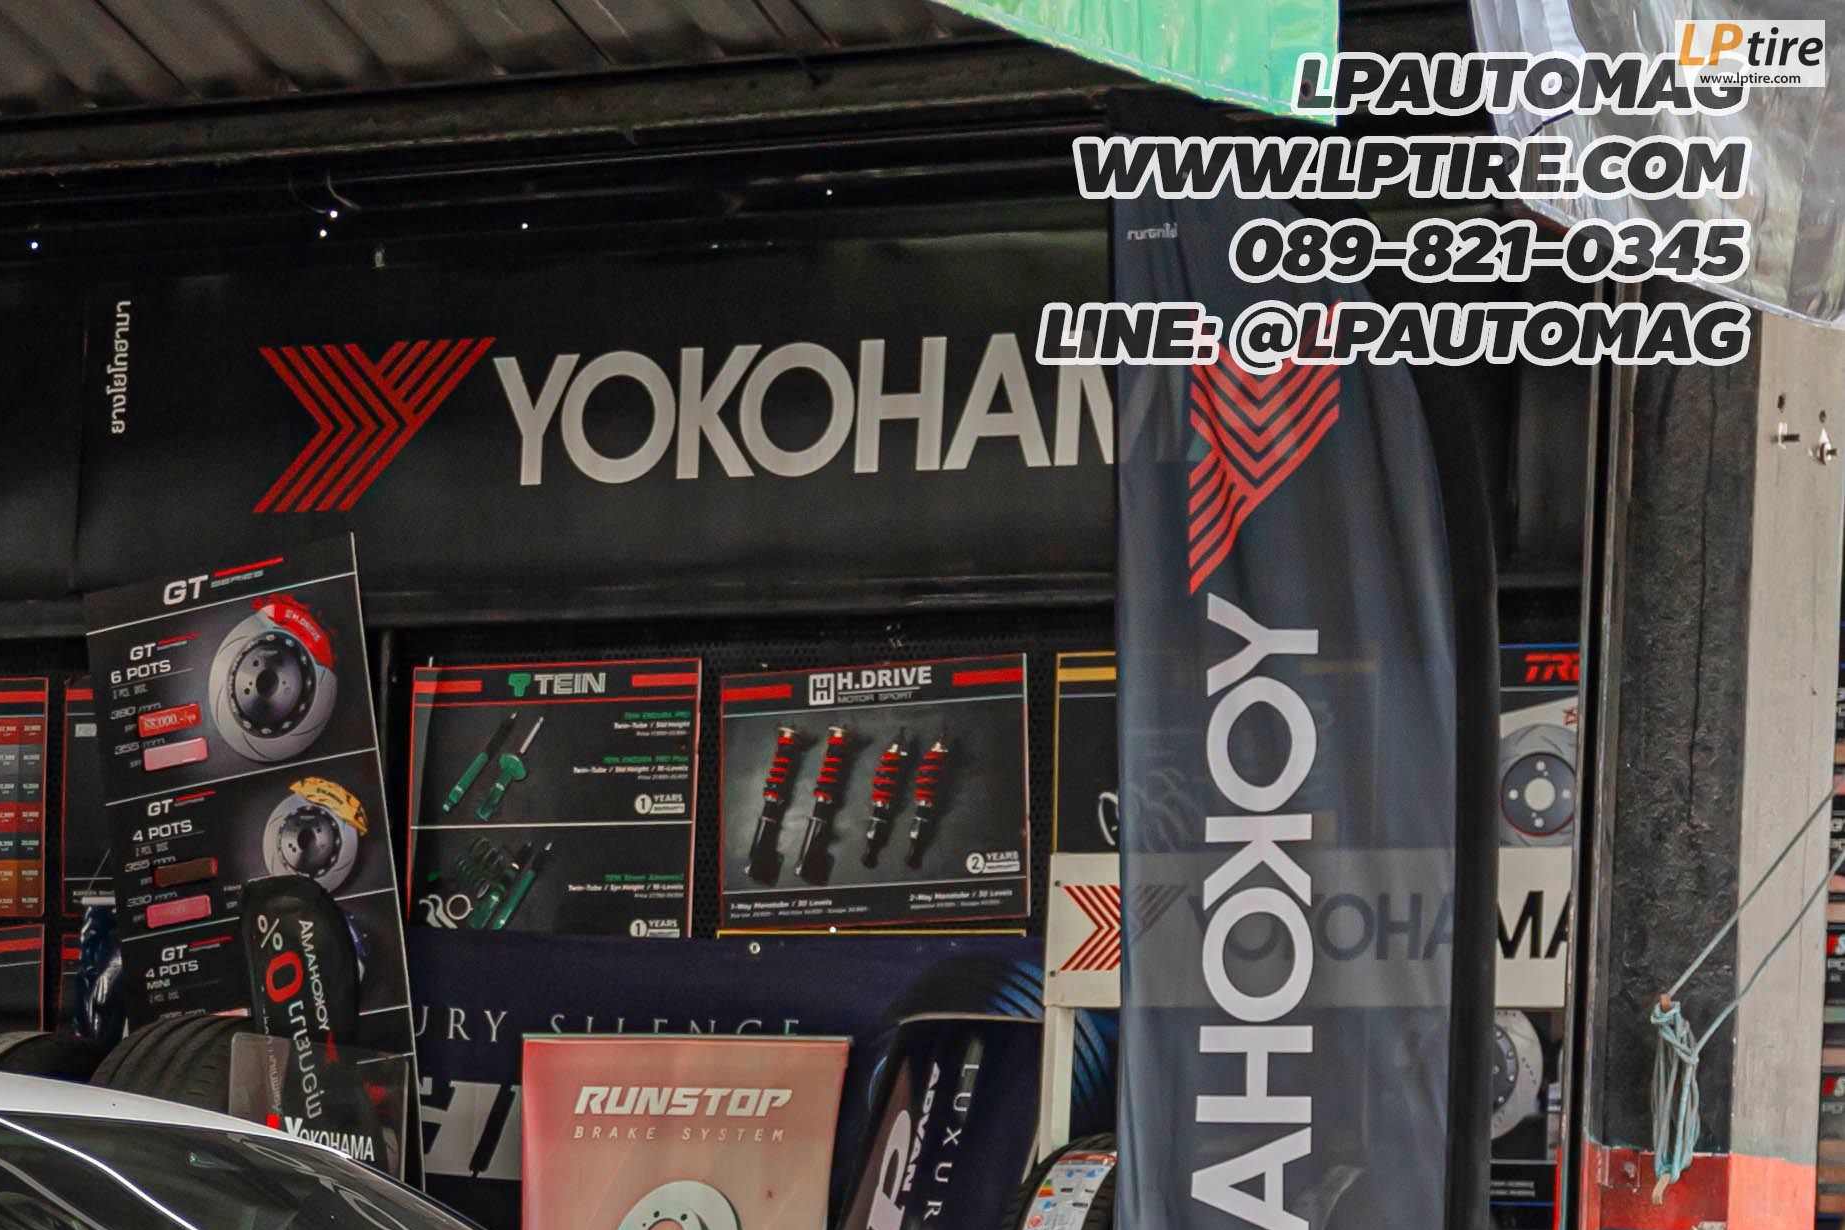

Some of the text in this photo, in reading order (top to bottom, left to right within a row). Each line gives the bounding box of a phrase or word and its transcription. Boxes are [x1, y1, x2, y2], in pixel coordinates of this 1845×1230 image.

[111, 301, 131, 434] ยางโยโกฮามา
[163, 575, 208, 606] GT
[130, 642, 156, 660] GT
[111, 660, 172, 684] 6 POTS
[534, 672, 606, 695] TEIN
[836, 666, 932, 690] H.DRIVE
[147, 799, 173, 816] GT
[132, 819, 193, 842] 4 POTS
[161, 944, 188, 961] GT
[145, 960, 200, 978] 4 POTS
[574, 1086, 793, 1116] RUNSTOP
[573, 1126, 784, 1142] BRAKE SYSTEM
[901, 1061, 940, 1192] ADVAN
